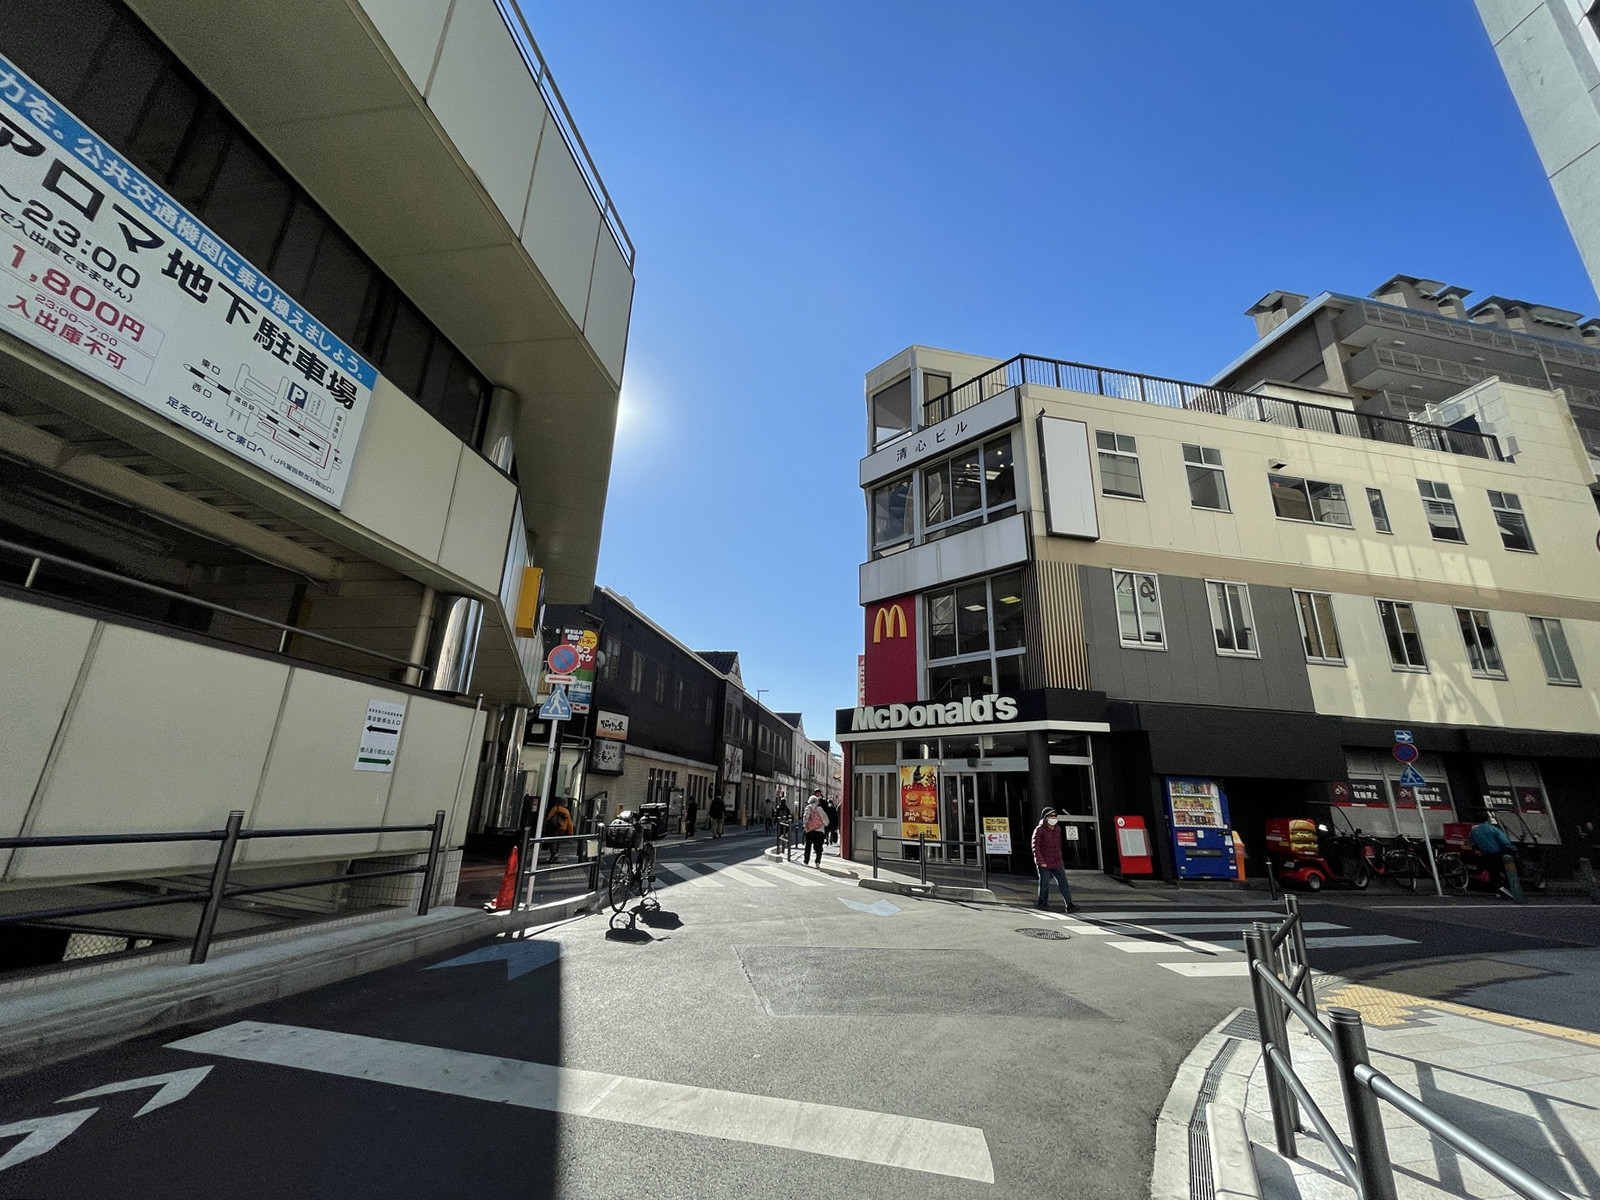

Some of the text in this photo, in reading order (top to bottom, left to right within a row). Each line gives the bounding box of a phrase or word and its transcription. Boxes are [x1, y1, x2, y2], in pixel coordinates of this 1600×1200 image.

[10, 244, 145, 343] 1,800円
[7, 294, 127, 371] 入出庫不可
[201, 358, 221, 375] 東口
[192, 382, 212, 398] 西口
[290, 385, 305, 402] P
[165, 396, 267, 457] 足をのばして東口へ
[896, 421, 967, 461] 清心ビル
[851, 693, 1018, 731] McDonald's
